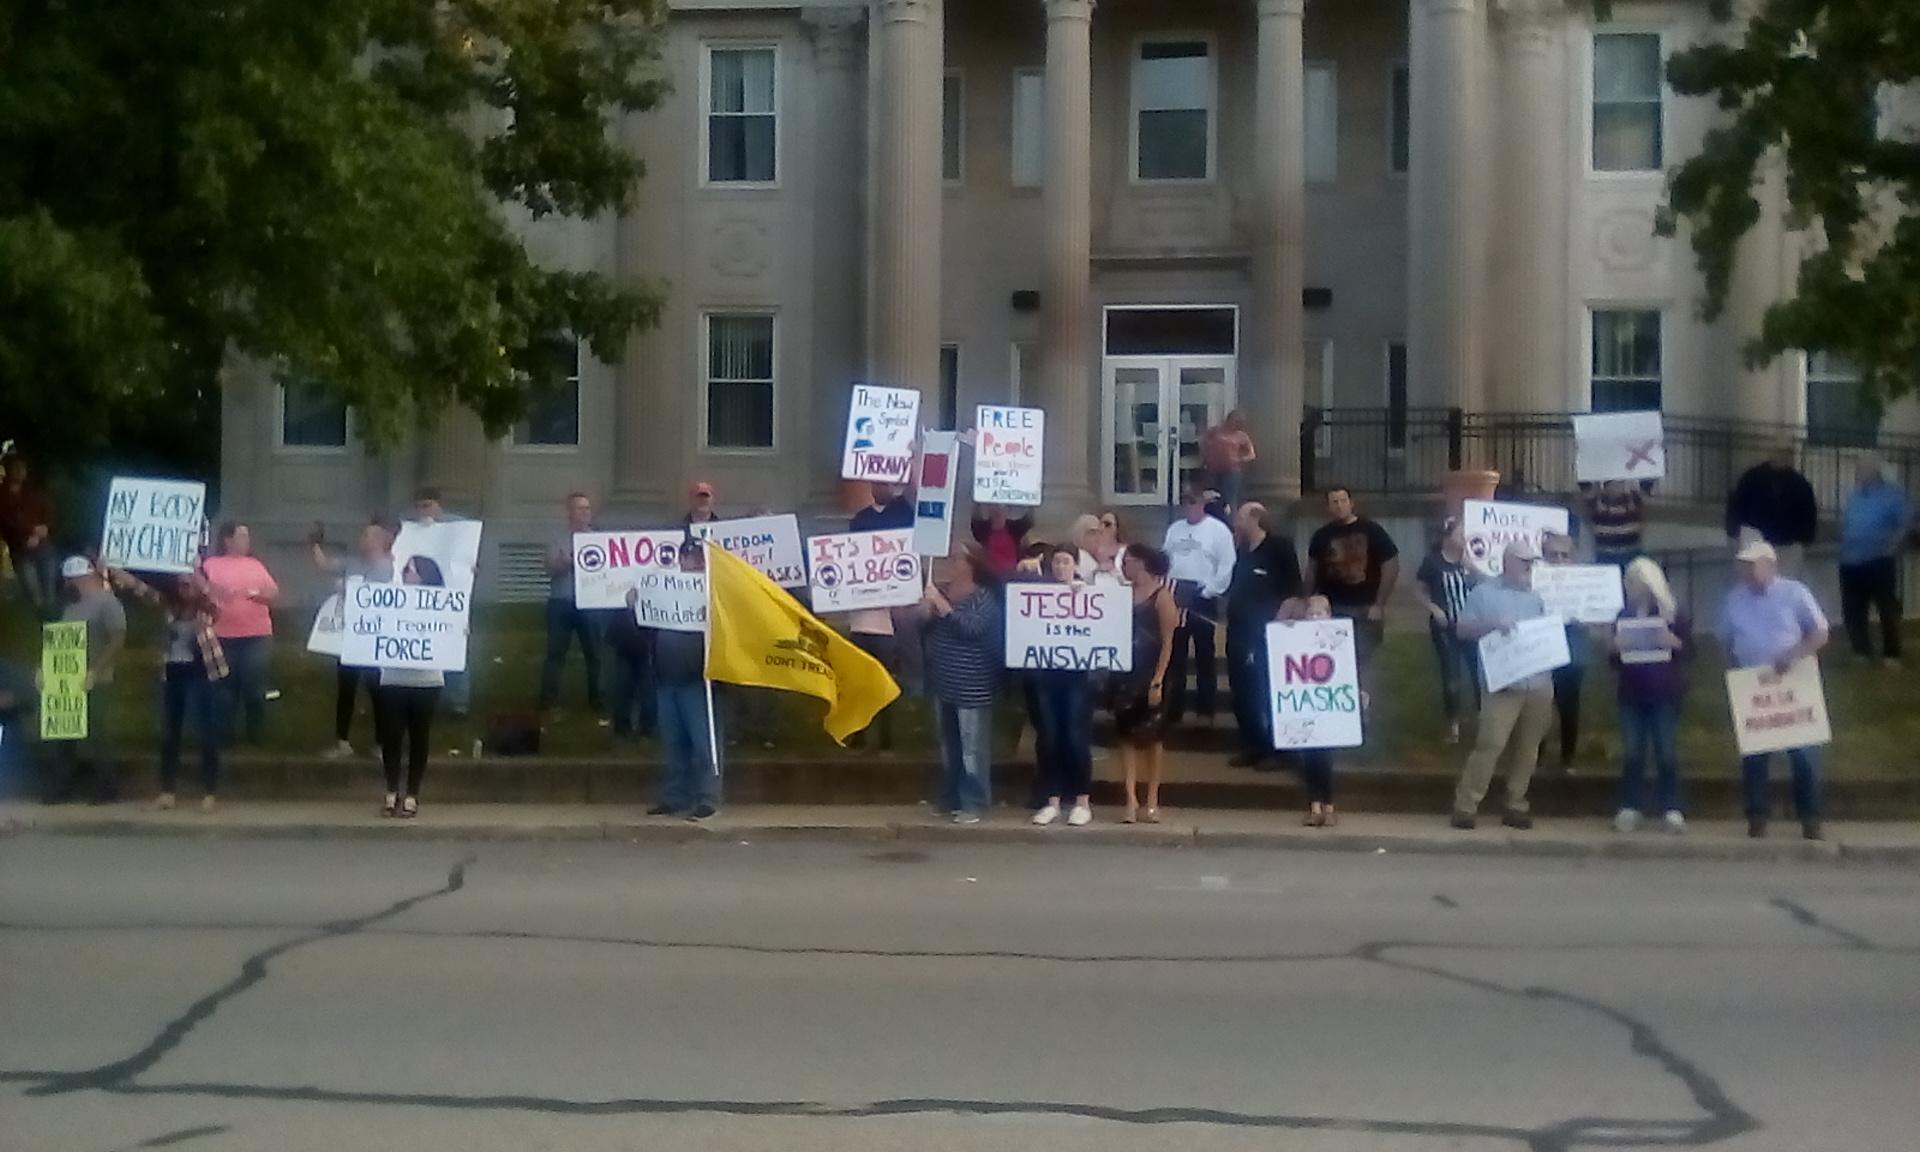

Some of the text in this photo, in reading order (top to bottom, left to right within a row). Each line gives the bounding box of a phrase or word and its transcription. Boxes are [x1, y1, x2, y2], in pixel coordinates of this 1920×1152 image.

[981, 408, 1033, 428] FREE
[110, 489, 138, 520] MY
[106, 523, 198, 565] MY CHOICE
[609, 537, 654, 568] NO
[872, 535, 908, 555] DAY
[356, 584, 465, 612] GOOD IDEAS
[1020, 591, 1104, 620] JESUS
[1046, 623, 1091, 637] is the
[374, 636, 433, 661] FORCE
[1024, 646, 1124, 671] ANSWER
[1284, 653, 1336, 685] NO
[1278, 684, 1356, 714] MASKS
